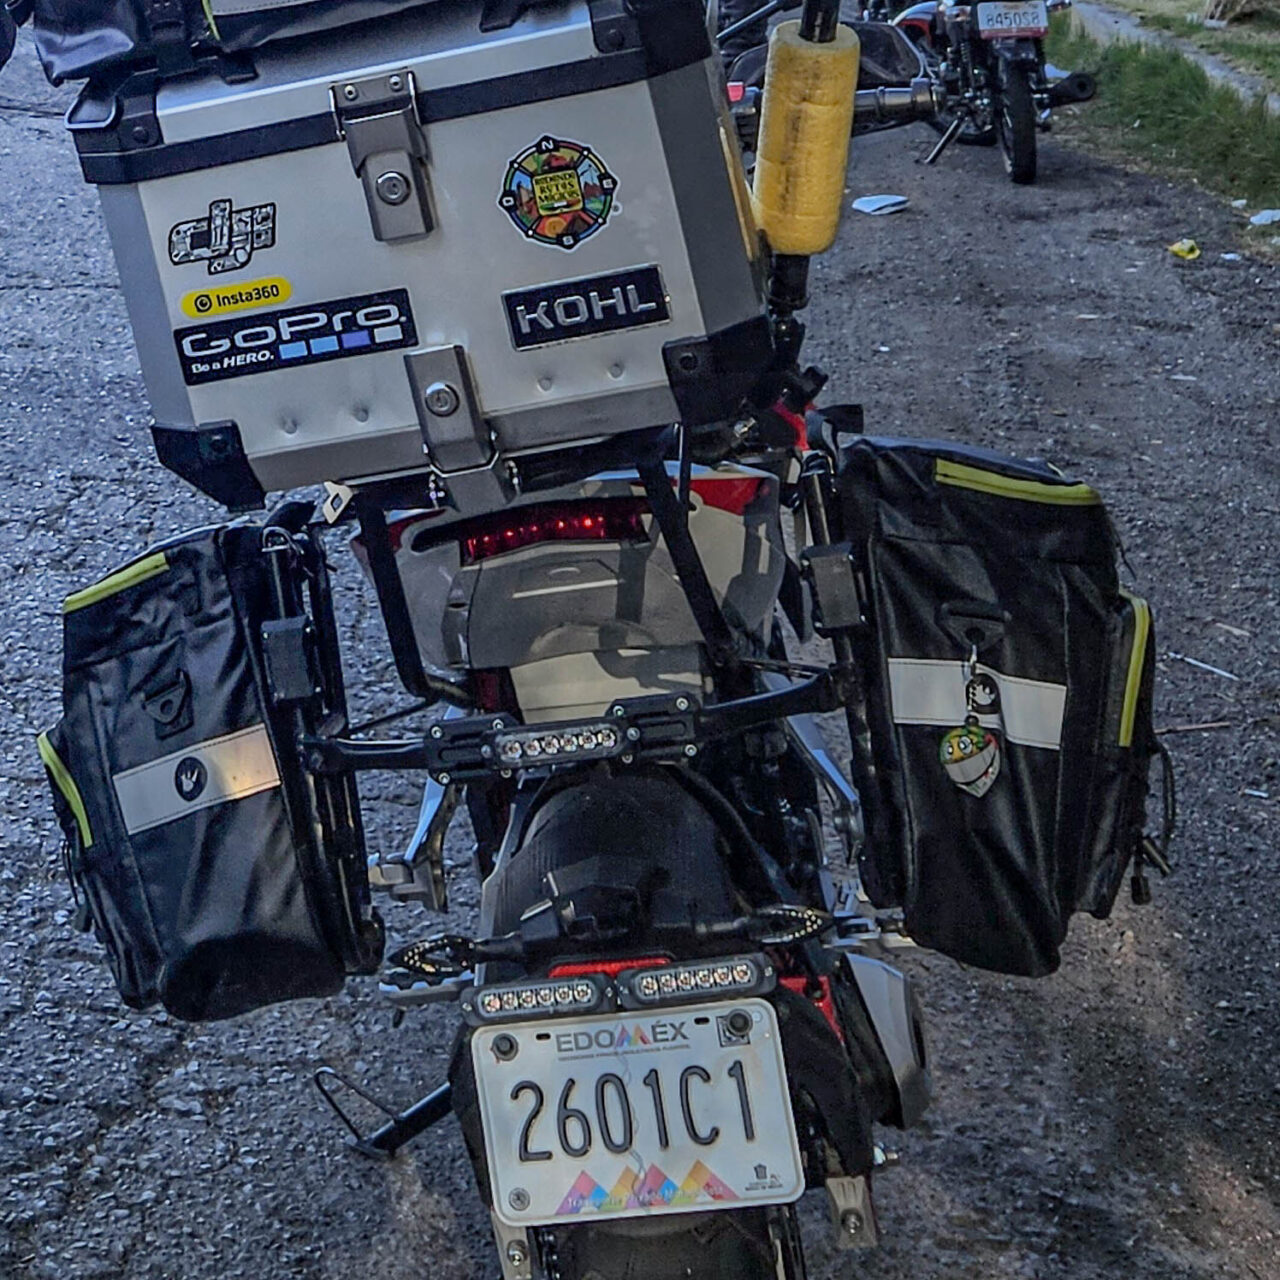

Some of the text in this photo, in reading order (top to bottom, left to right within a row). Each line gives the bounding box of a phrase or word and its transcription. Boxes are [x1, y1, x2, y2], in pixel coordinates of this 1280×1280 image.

[216, 284, 280, 308] Insta360
[516, 284, 657, 334] KOHL
[510, 1059, 755, 1163] 2601C1
